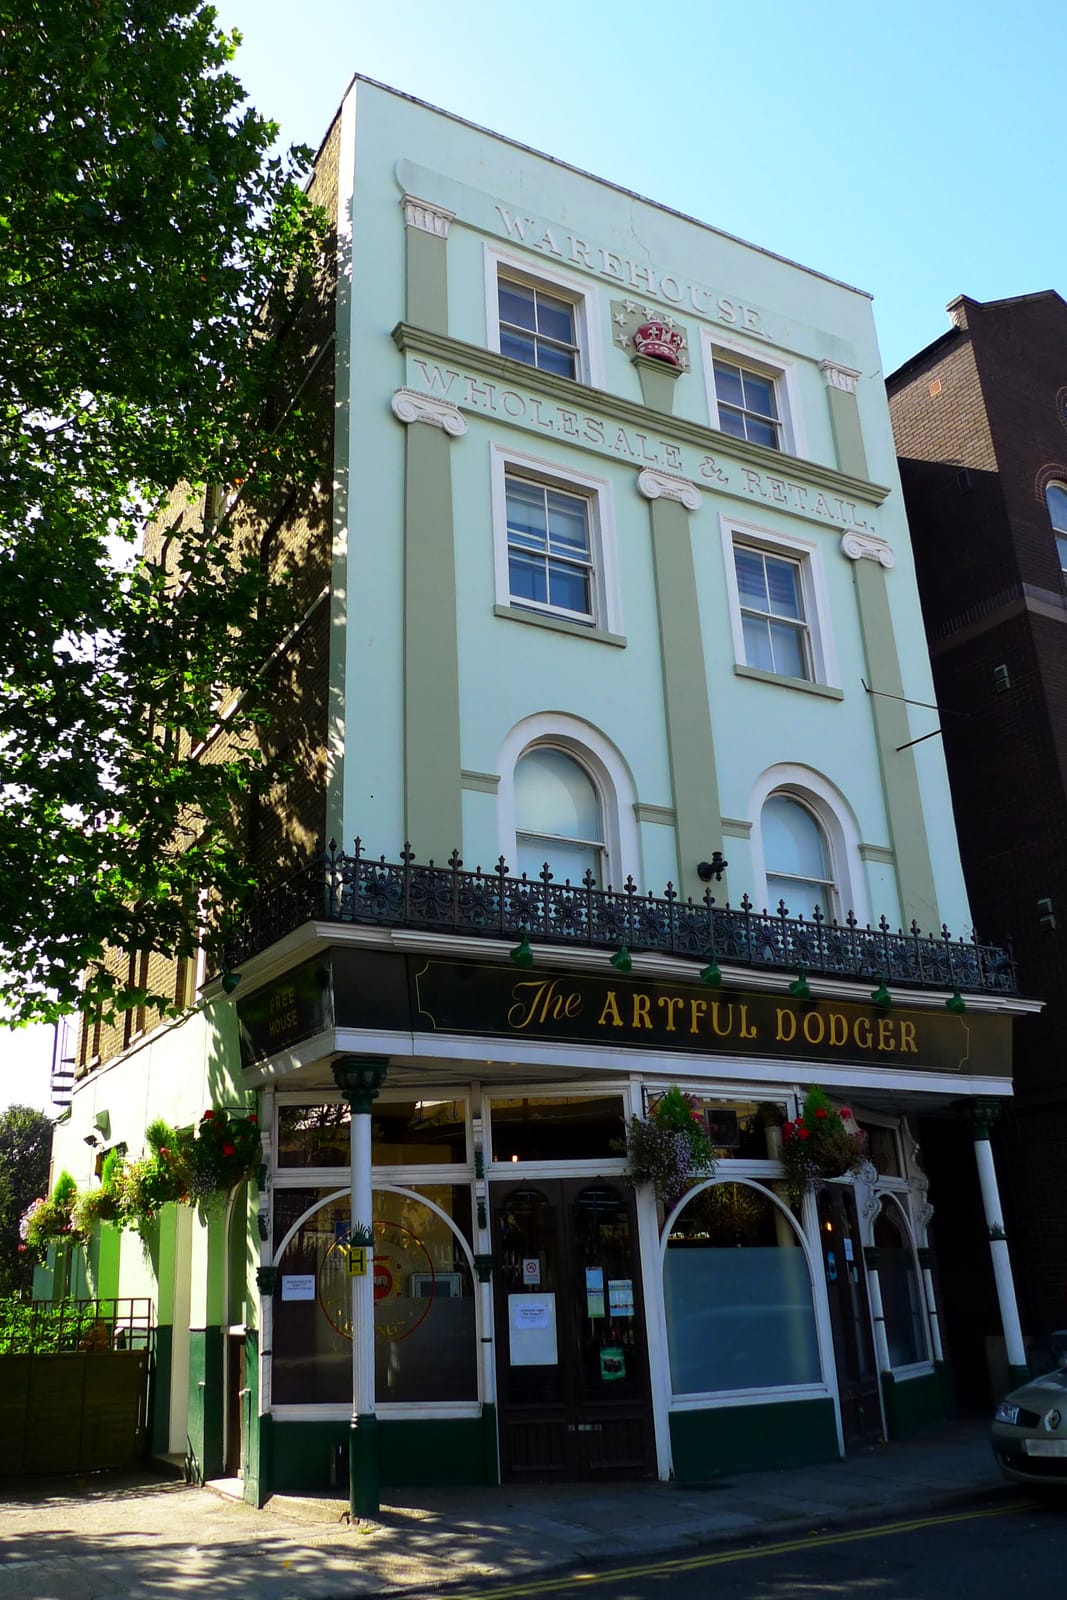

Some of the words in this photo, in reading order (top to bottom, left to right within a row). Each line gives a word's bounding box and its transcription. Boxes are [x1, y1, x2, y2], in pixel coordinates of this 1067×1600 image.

[413, 360, 683, 471] WHOLESALE
[699, 455, 729, 485] &
[270, 988, 296, 1014] FREE
[507, 977, 584, 1029] The
[598, 991, 758, 1039] ARTFUL
[775, 1007, 918, 1052] DODGER
[268, 1009, 298, 1039] HOUSE
[349, 1250, 363, 1272] H
